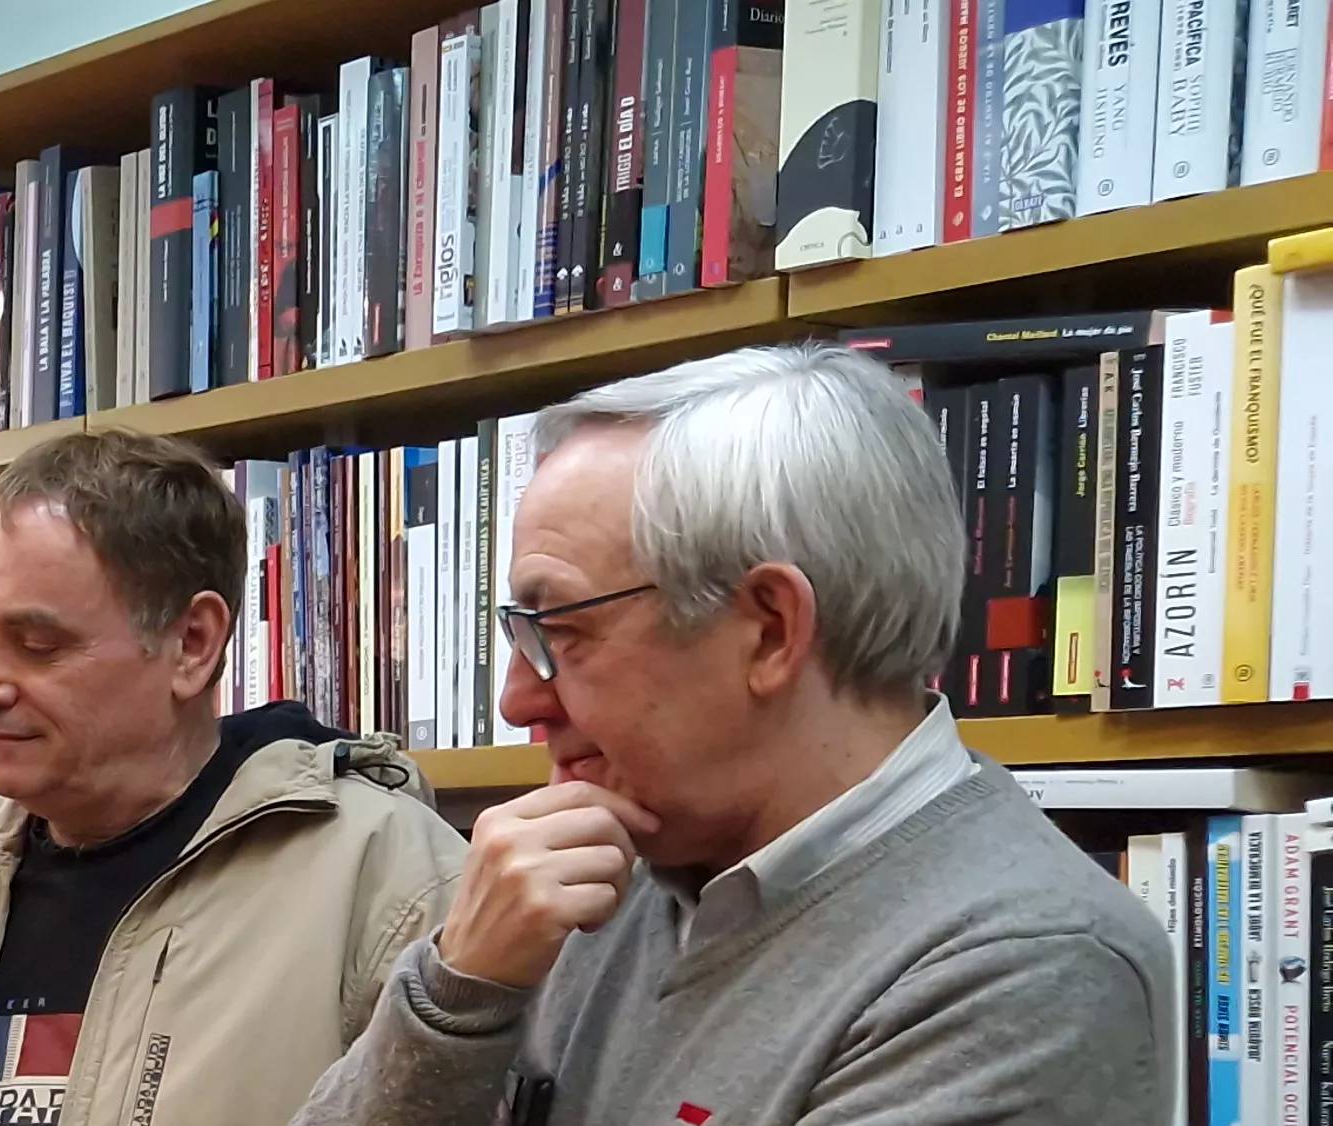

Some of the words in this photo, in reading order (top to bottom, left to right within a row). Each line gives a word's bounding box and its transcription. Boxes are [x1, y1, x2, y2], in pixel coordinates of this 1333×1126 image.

[1285, 0, 1300, 28] ARET
[957, 27, 969, 70] JUEGOS
[1184, 1, 1207, 66] PACÍFICA
[956, 74, 968, 95] LOS
[956, 98, 967, 113] DE
[1111, 84, 1127, 132] YANG
[1168, 78, 1188, 138] BABY
[1186, 74, 1205, 134] SOPHIE
[955, 116, 966, 150] LIBRO
[1091, 87, 1108, 160] JISHENG
[954, 151, 965, 182] GRAN
[953, 185, 964, 198] EL
[40, 248, 52, 298] PALABRA
[435, 233, 458, 300] riglos
[39, 300, 50, 314] LA
[1247, 283, 1266, 318] ¿QUÉ
[38, 325, 50, 355] BALA
[61, 340, 75, 358] EL
[1248, 321, 1263, 346] FUE
[38, 356, 49, 372] LA
[1170, 338, 1187, 399] FRANCISCO
[1248, 349, 1262, 365] EL
[1129, 368, 1143, 390] José
[1187, 356, 1203, 397] FUSTER
[1129, 392, 1142, 427] Carlos
[1243, 368, 1262, 464] FRANQUISMO?
[1170, 421, 1185, 473] moderno
[976, 480, 987, 490] El
[1007, 477, 1017, 488] La
[1167, 485, 1184, 527] Clásico
[1160, 547, 1198, 659] AZORÍN
[476, 609, 488, 666] ANTOLOGÍA
[1249, 831, 1263, 891] DEMOCRACIA
[1284, 834, 1299, 881] ADAM
[1167, 891, 1177, 907] del
[1249, 892, 1263, 904] LA
[1284, 885, 1298, 940] GRANT
[1248, 913, 1263, 942] JAQUE
[1283, 1005, 1298, 1087] POTENCIAL
